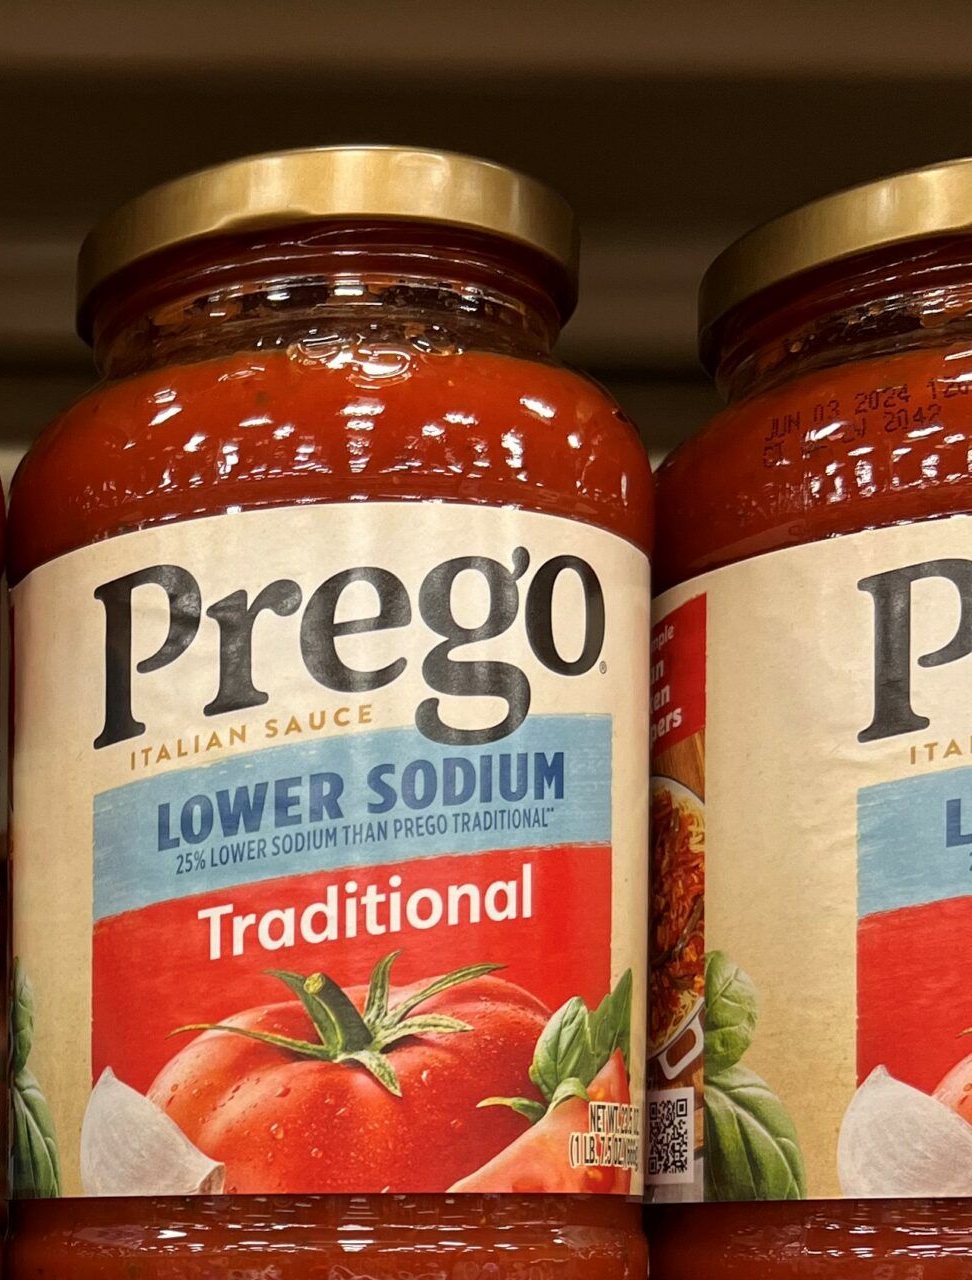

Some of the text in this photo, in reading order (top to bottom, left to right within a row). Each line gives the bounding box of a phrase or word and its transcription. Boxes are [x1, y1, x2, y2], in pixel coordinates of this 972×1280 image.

[93, 546, 605, 750] Prego
[131, 704, 372, 770] ITALIAN SAUCE
[157, 751, 566, 853] LOWER SODIUM
[175, 815, 447, 875] 25% LOWER SODIUM THAN PREGO
[198, 863, 532, 962] Traditional
